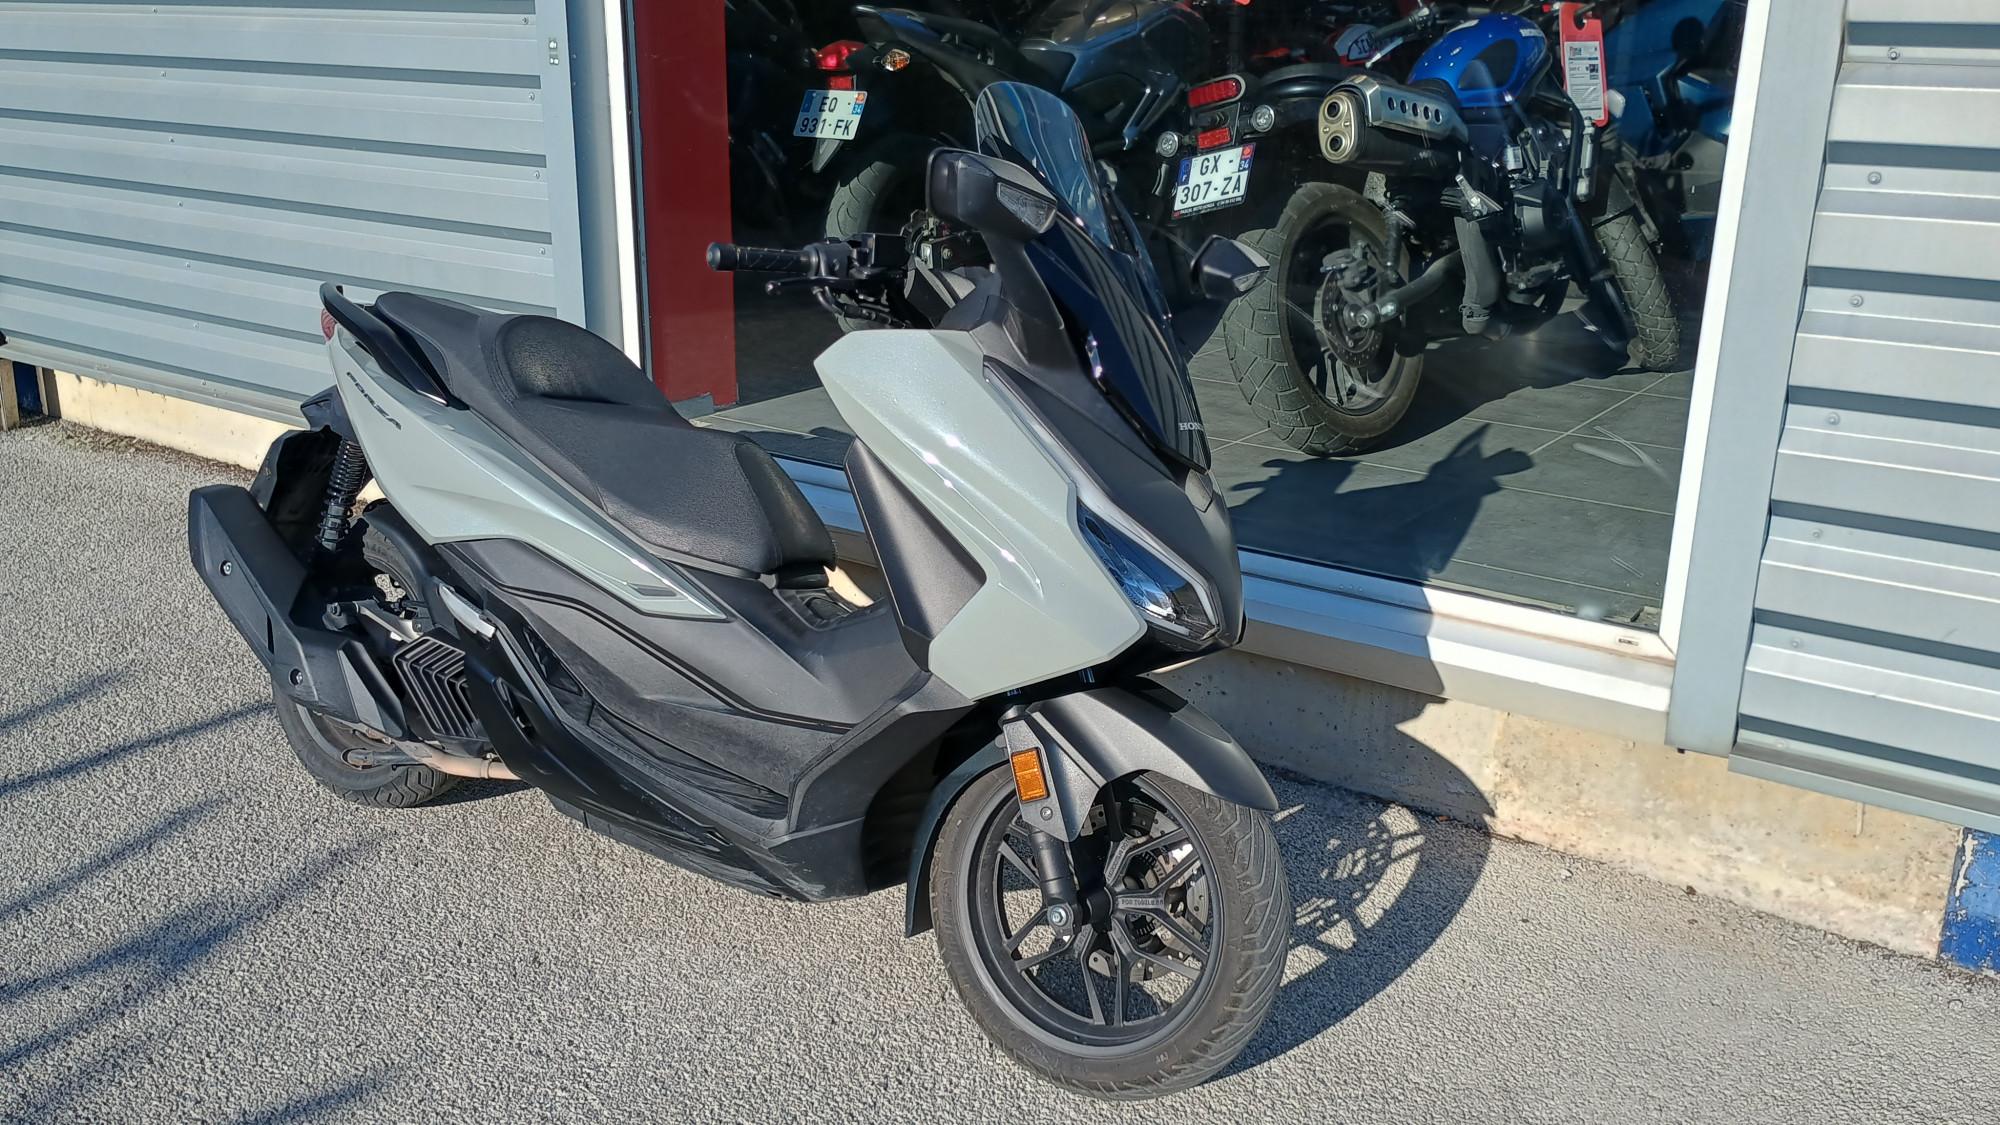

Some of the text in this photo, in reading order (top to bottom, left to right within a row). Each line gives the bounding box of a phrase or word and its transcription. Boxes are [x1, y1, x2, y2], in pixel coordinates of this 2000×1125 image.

[818, 96, 838, 113] EQ
[1200, 154, 1221, 176] GX
[1240, 159, 1250, 170] 34
[1180, 174, 1241, 205] 307-ZA
